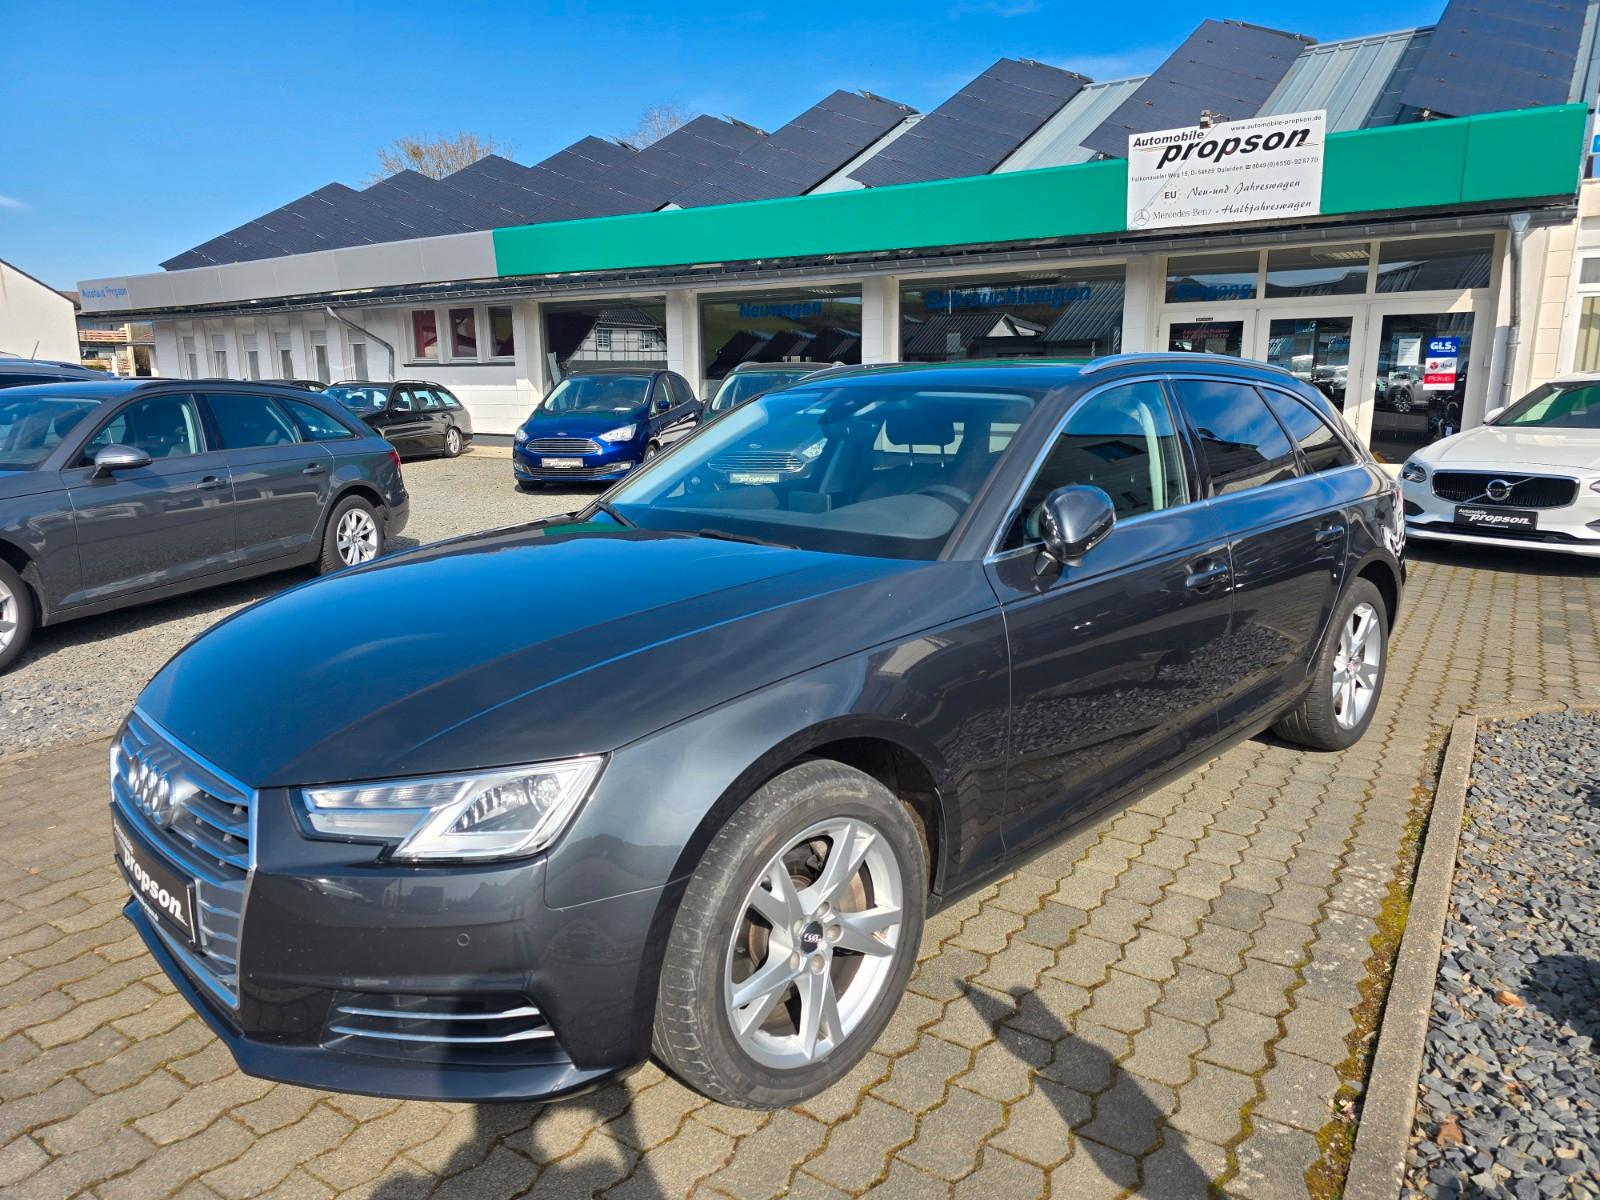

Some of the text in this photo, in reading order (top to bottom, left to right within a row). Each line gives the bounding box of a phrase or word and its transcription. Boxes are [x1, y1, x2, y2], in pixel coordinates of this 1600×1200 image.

[1133, 130, 1204, 147] Automobile
[1156, 128, 1310, 170] propson
[1233, 179, 1301, 195] Jahreswagen
[1164, 191, 1177, 199] EU
[1430, 342, 1451, 350] GLS
[1428, 375, 1451, 383] Pickup
[1469, 514, 1529, 524] propson
[124, 847, 184, 923] propson
